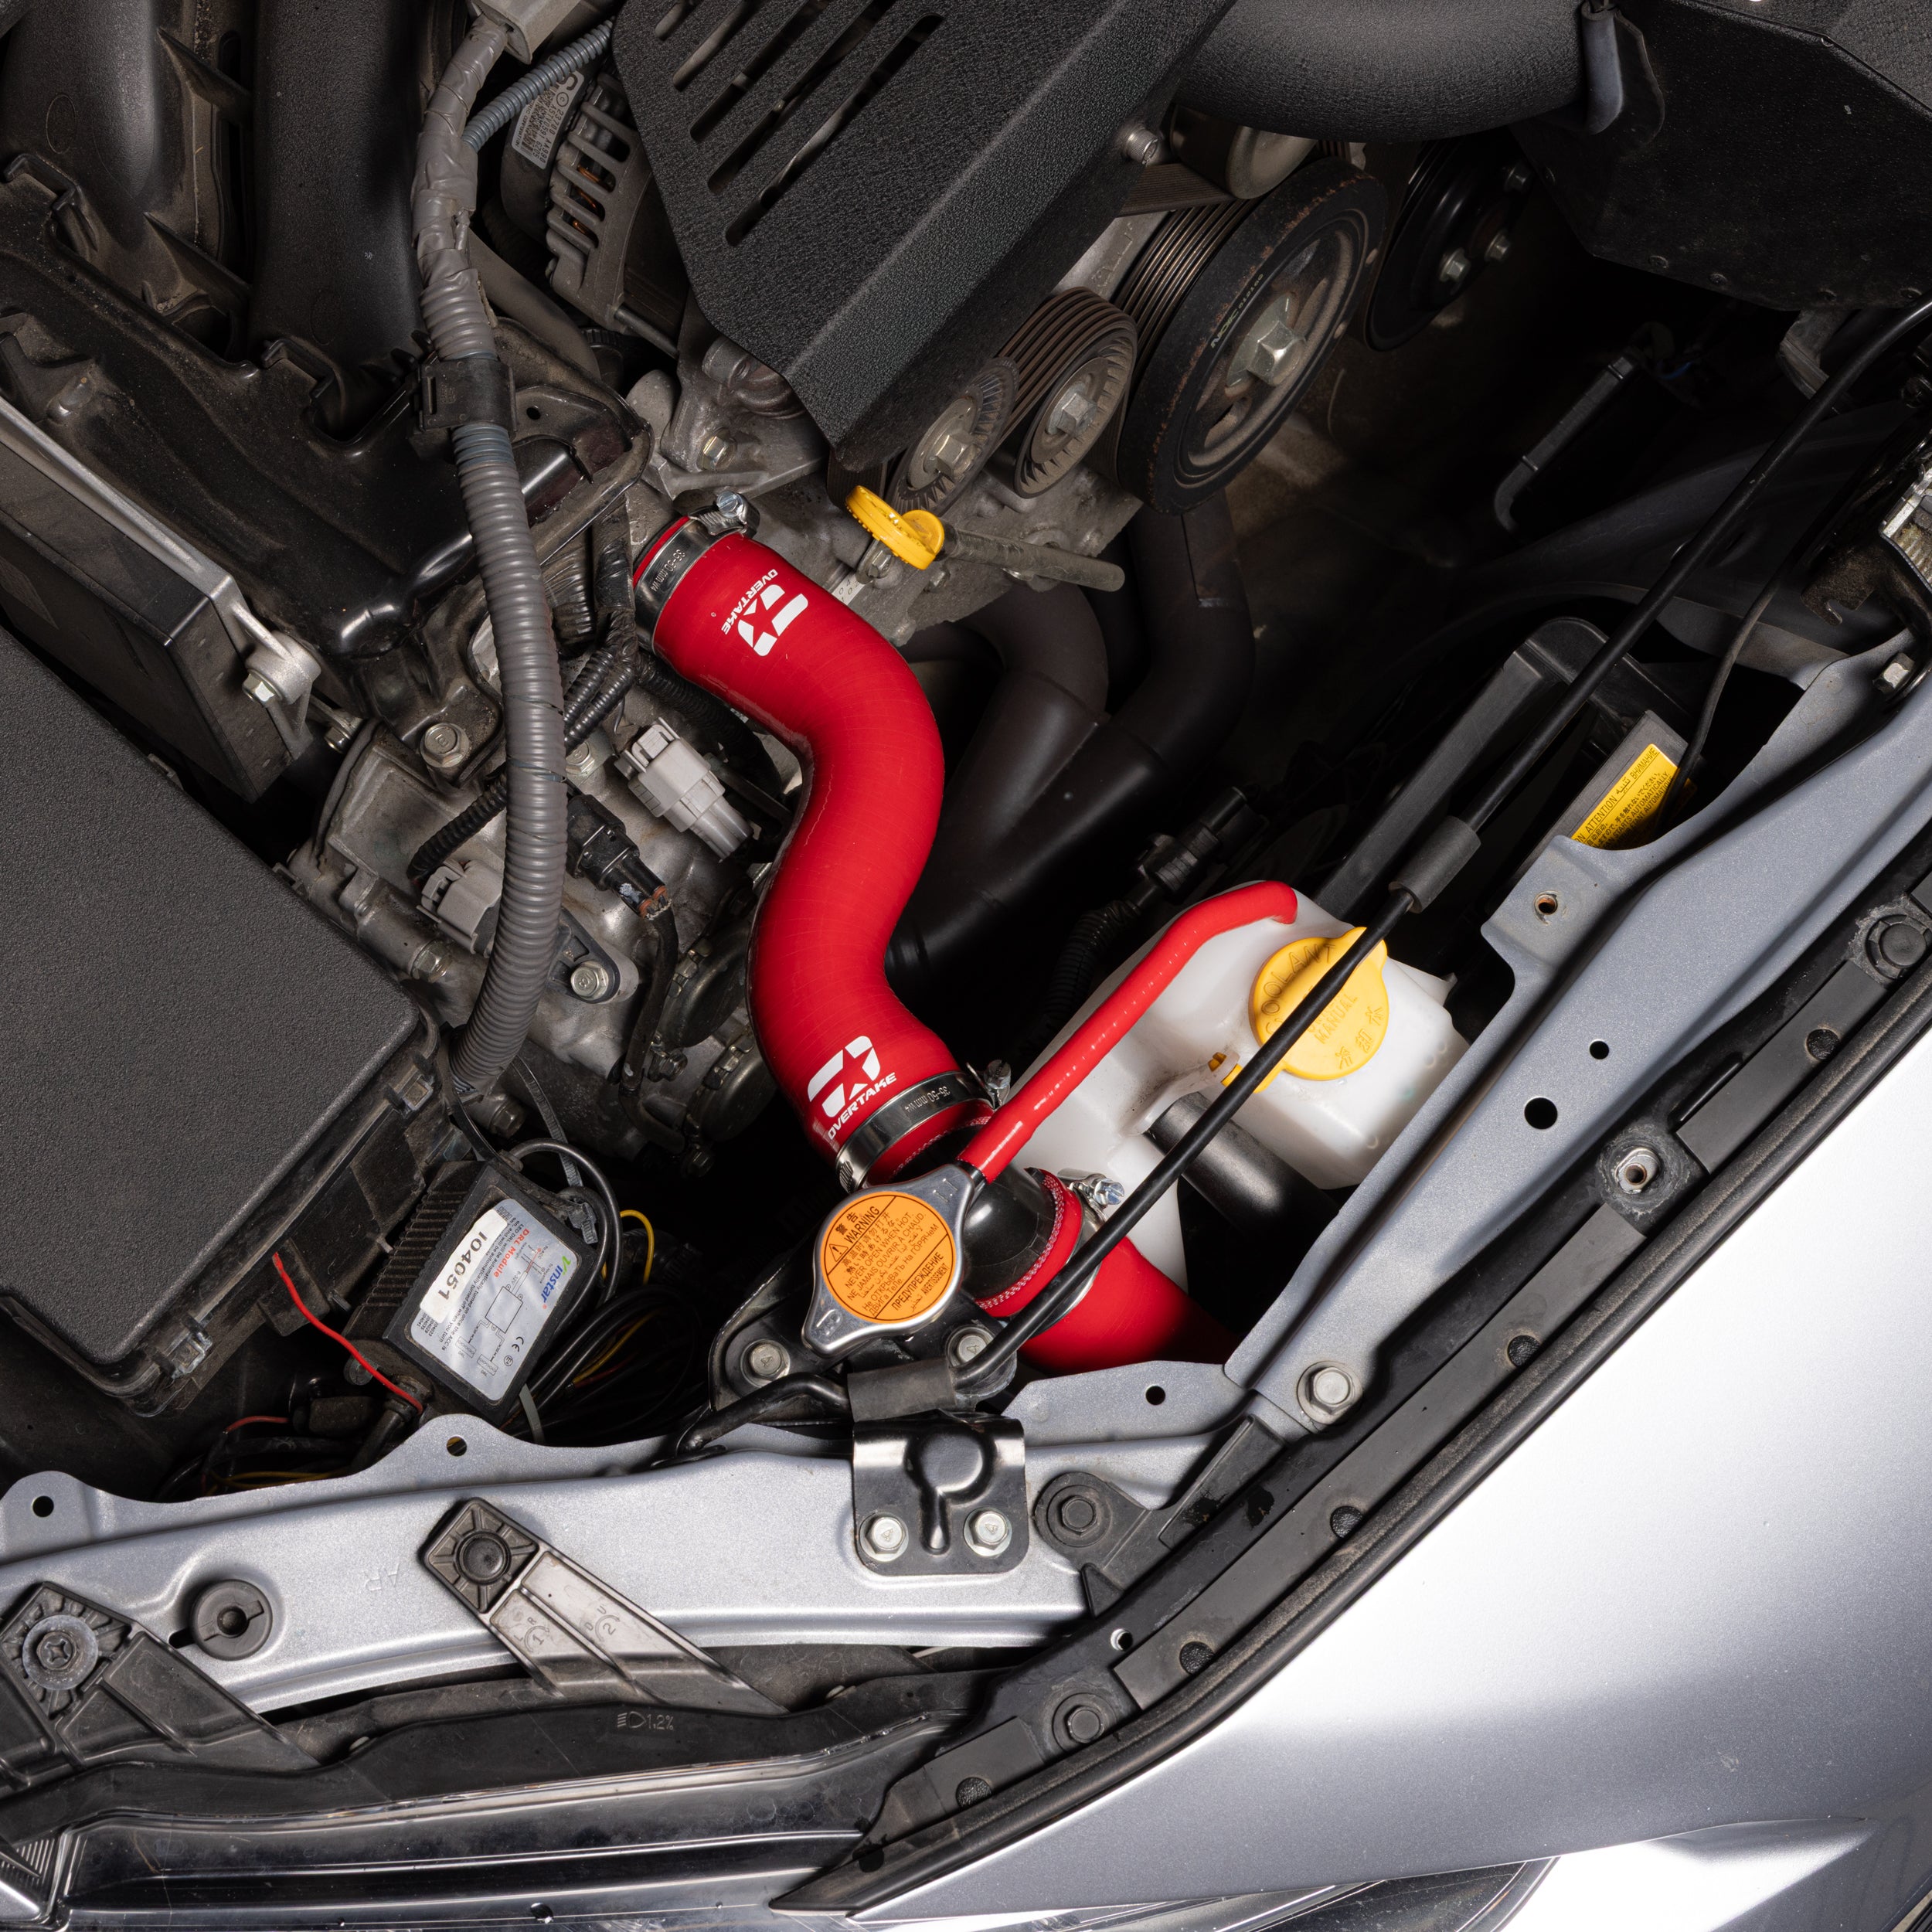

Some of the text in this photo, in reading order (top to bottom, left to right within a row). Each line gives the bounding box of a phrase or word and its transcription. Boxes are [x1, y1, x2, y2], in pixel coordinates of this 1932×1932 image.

[548, 108, 564, 135] 23700
[721, 569, 778, 634] OVERTAKE
[1582, 794, 1618, 834] ATTENTION
[1628, 747, 1658, 779] ВНИМАНИЕ
[1612, 815, 1633, 838] STARTS
[1628, 770, 1670, 817] AUTOMATICALLY.
[1261, 943, 1335, 1034] COOLANT
[1314, 993, 1359, 1044] MANUAL
[827, 1073, 897, 1140] OVERTAKE
[502, 1226, 512, 1237] and
[513, 1223, 524, 1235] LED
[843, 1204, 881, 1244] WARNING
[497, 1235, 506, 1247] will
[506, 1233, 515, 1244] DRL
[513, 1226, 530, 1247] DRL
[492, 1244, 500, 1253] be
[499, 1241, 509, 1253] will
[536, 1249, 546, 1260] ACC
[844, 1209, 914, 1288] NEVER OPEN WHEN HOT.
[846, 1288, 859, 1301] NE
[855, 1265, 879, 1291] JAMAIS
[875, 1240, 900, 1267] OUVRIR
[901, 1210, 926, 1237] CHAUD.
[471, 1251, 496, 1285] automatically
[492, 1245, 517, 1279] Module
[474, 1257, 499, 1291] automatically
[536, 1254, 573, 1304] Vinstar
[889, 1250, 946, 1311] ПРЕДУПРЕЖДЕНИЕ
[919, 1262, 951, 1295] AVERTISSEMENT
[462, 1284, 477, 1301] turned
[466, 1290, 481, 1308] turned
[458, 1300, 468, 1309] off
[451, 1307, 463, 1322] when
[455, 1313, 467, 1327] once
[444, 1320, 454, 1332] you
[450, 1325, 459, 1335] the
[438, 1330, 448, 1343] turn
[444, 1334, 454, 1346] ACC
[646, 1713, 674, 1730] 1.2%
